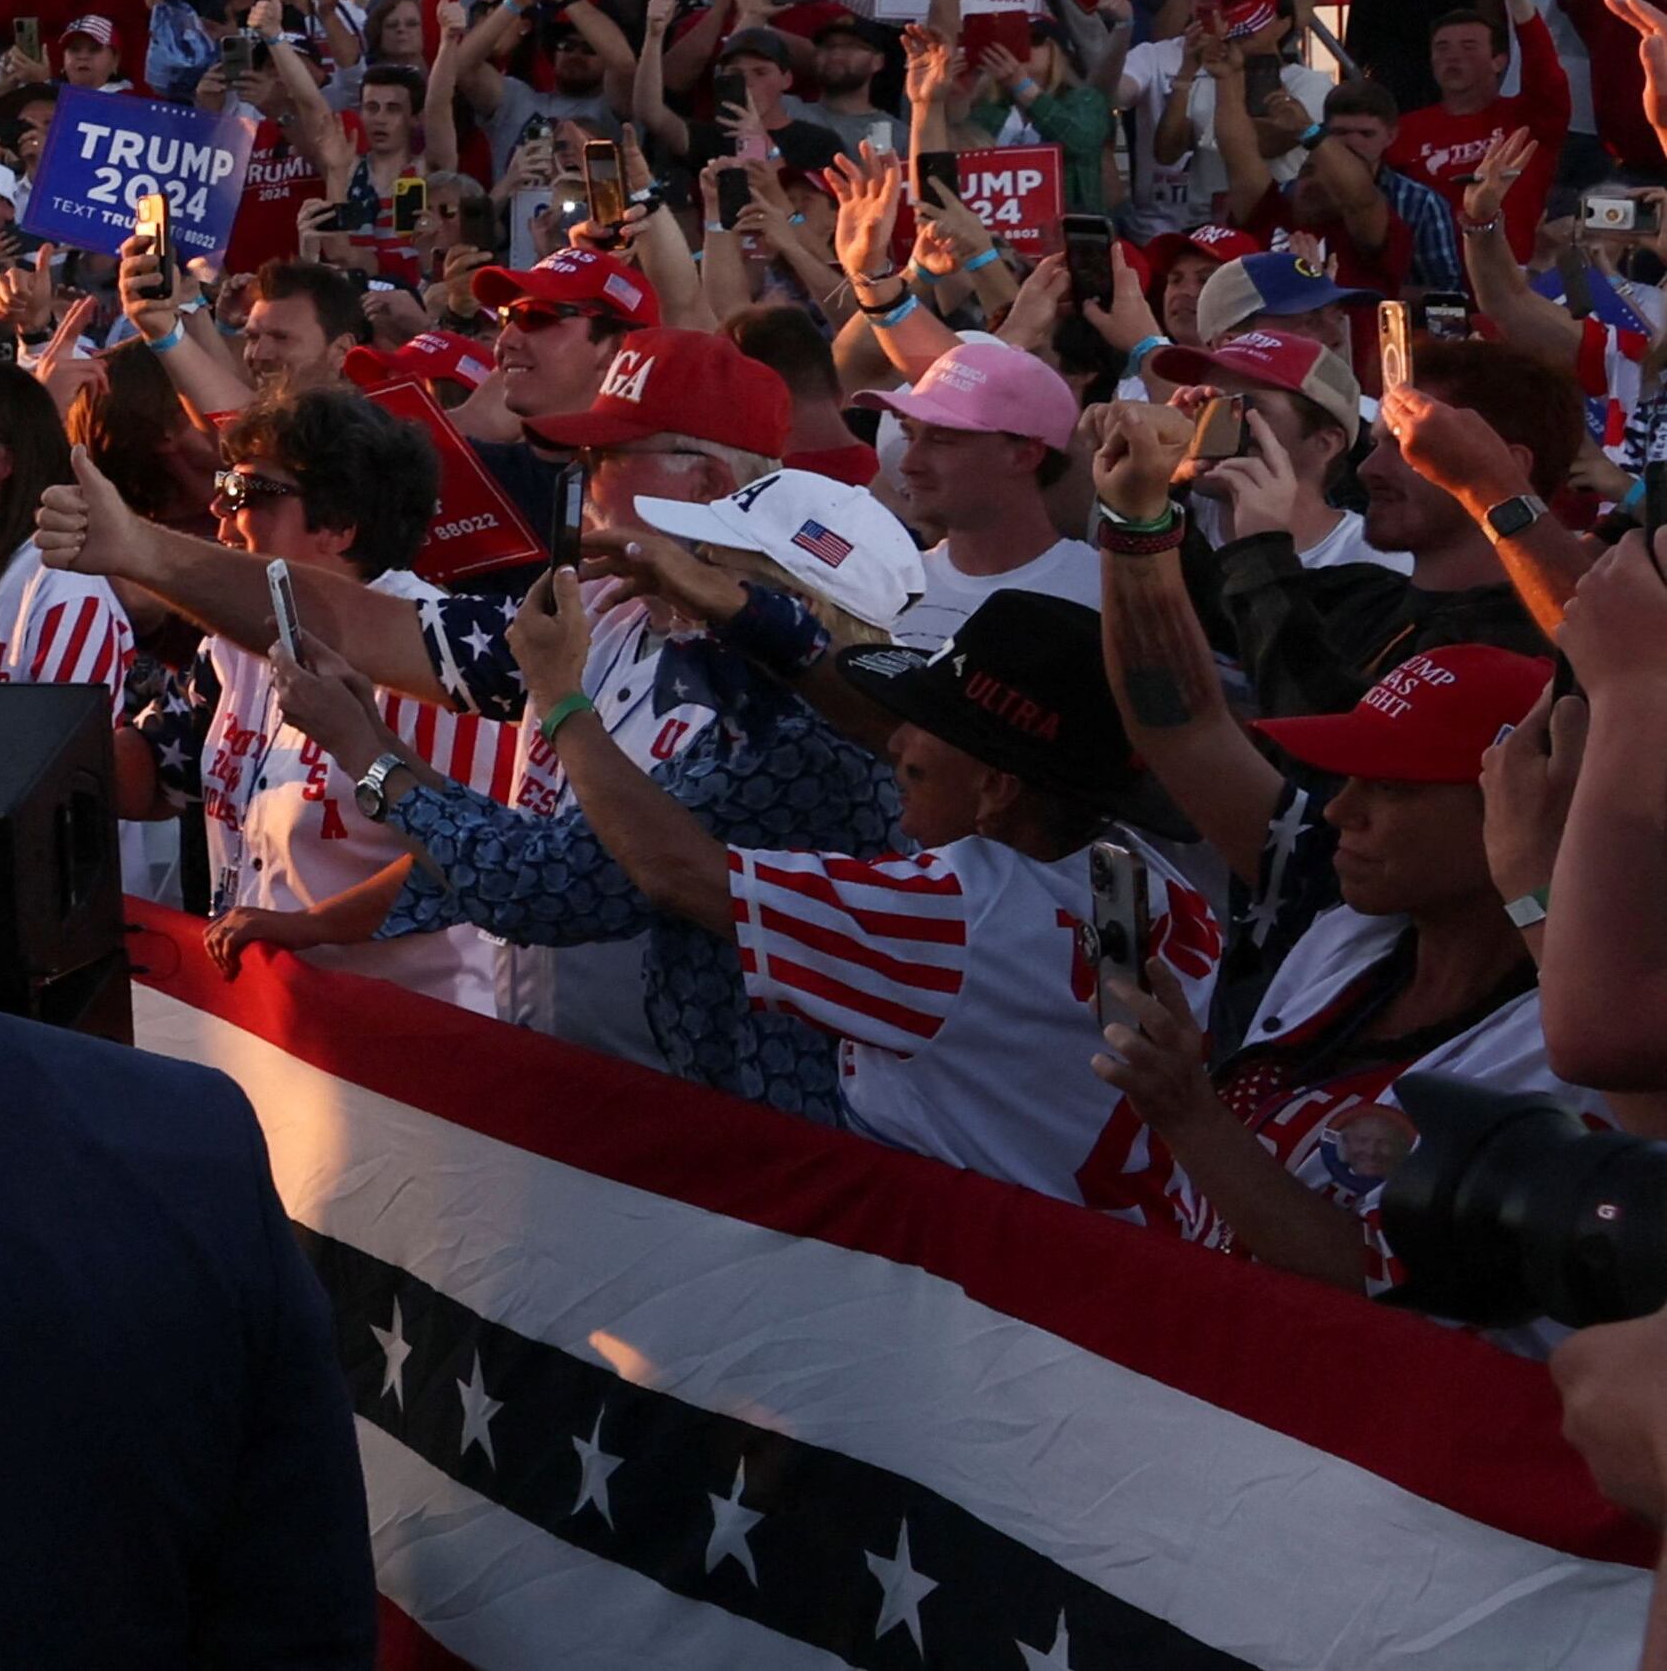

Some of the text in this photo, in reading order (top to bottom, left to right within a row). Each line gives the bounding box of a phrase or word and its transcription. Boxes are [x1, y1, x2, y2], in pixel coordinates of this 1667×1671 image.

[77, 121, 235, 186] TRUMP
[51, 196, 97, 220] TEXT
[101, 209, 137, 230] TRU
[86, 166, 210, 224] 2024
[258, 186, 291, 202] 2024
[599, 349, 656, 404] GA
[434, 512, 500, 540] 88022
[964, 668, 1065, 745] ULTRA
